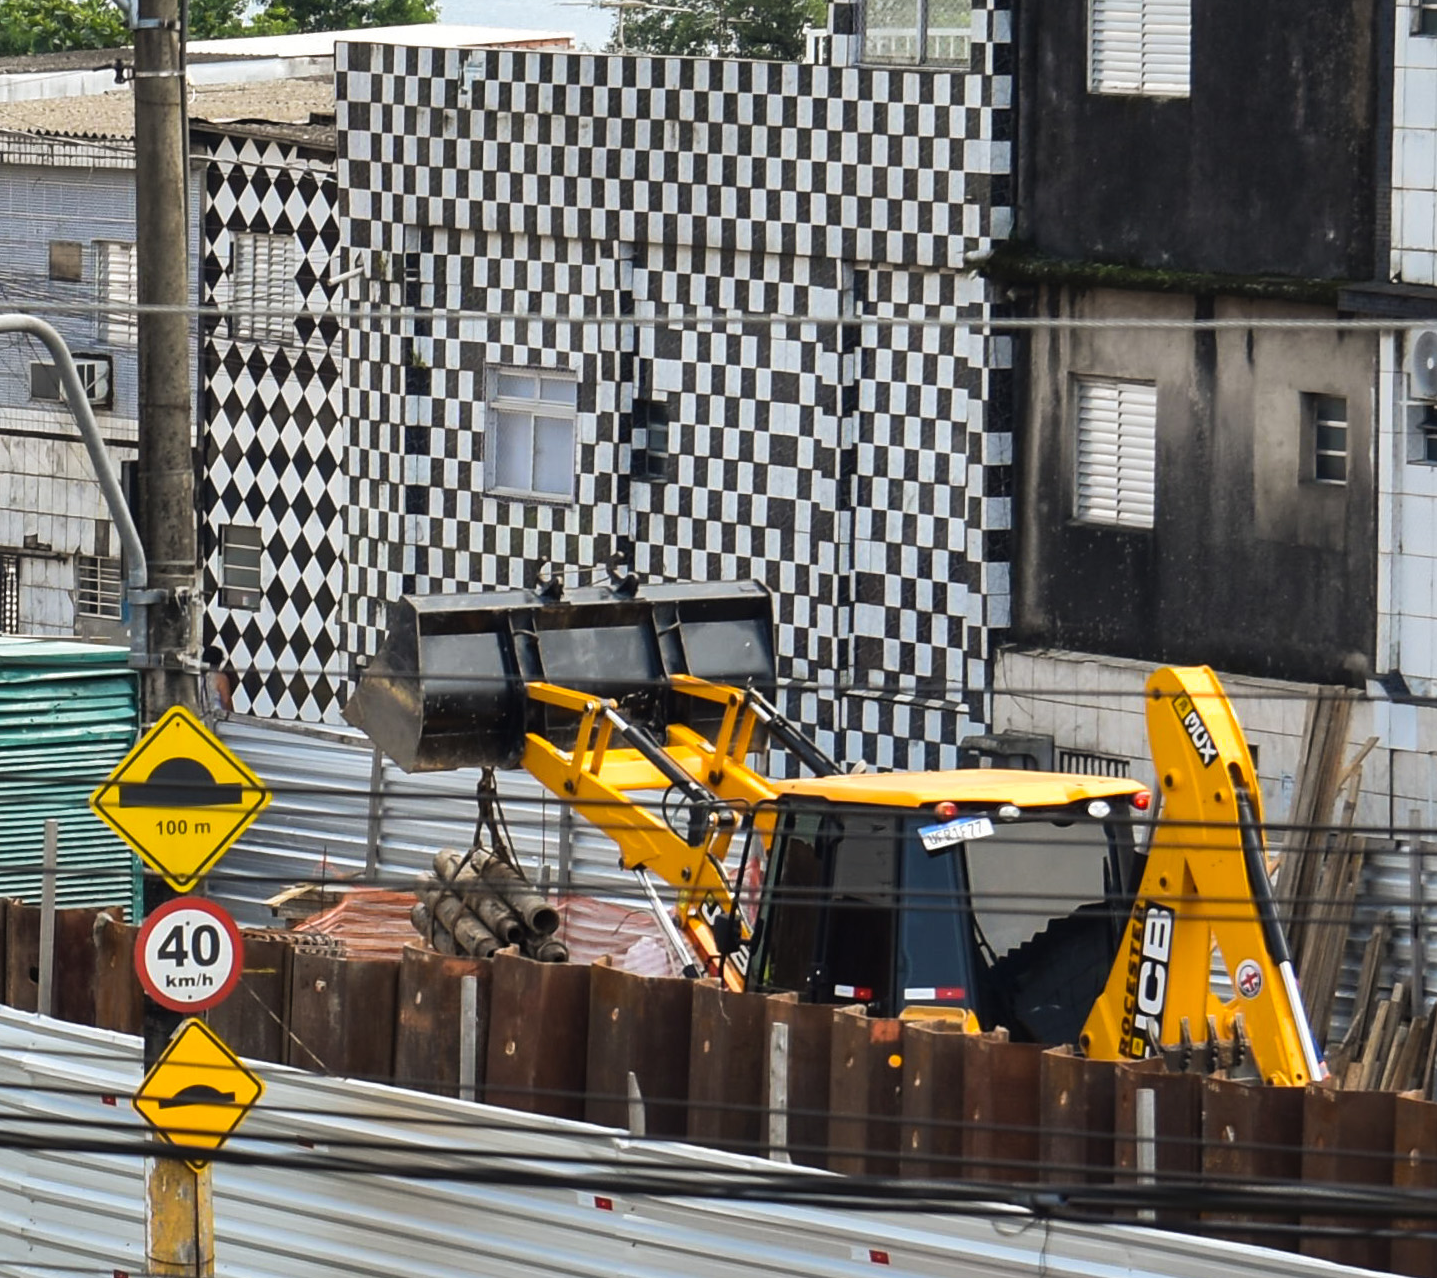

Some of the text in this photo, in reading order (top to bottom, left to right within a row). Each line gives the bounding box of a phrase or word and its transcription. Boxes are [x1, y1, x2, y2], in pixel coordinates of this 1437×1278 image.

[155, 819, 212, 836] 100 m
[157, 924, 221, 968] 40
[165, 973, 214, 990] km/h
[1134, 907, 1172, 1059] JCB
